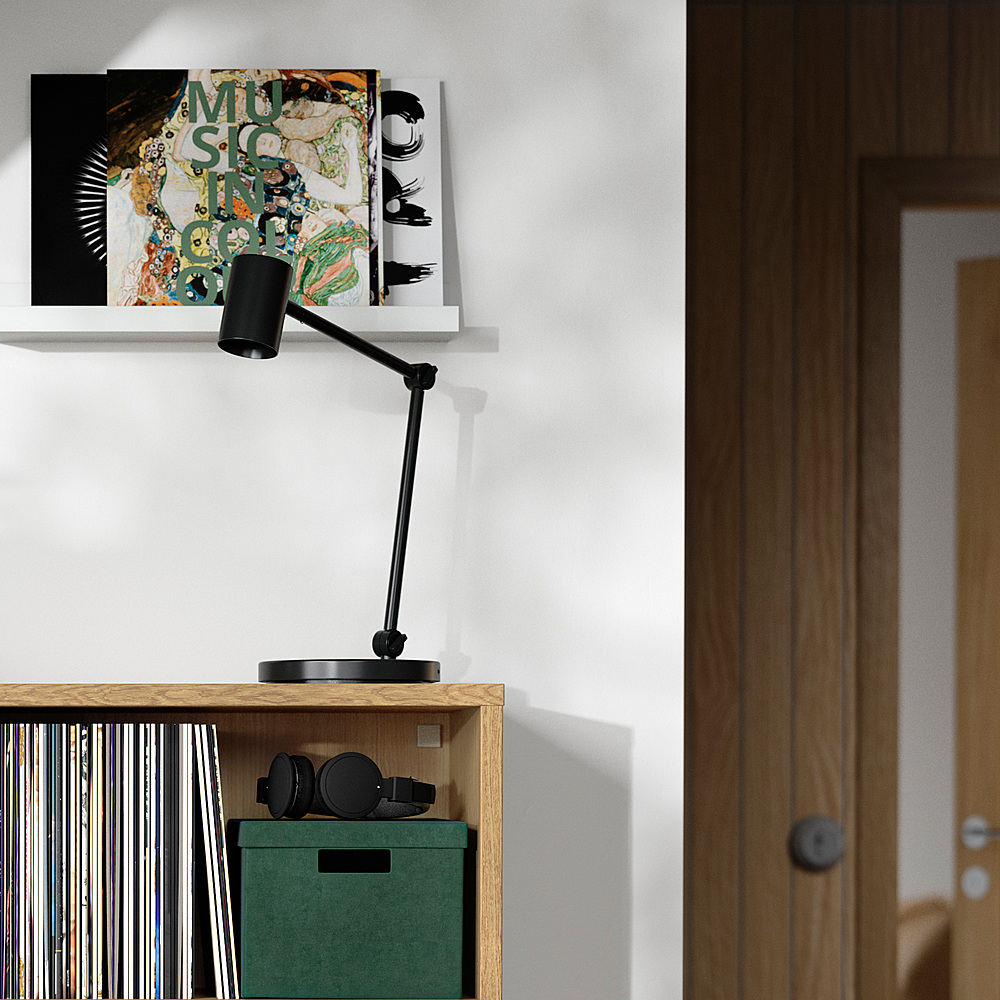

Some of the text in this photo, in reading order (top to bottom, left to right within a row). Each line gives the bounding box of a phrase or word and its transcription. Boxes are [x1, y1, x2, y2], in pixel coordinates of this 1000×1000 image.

[188, 80, 283, 123] MU
[191, 125, 280, 169] SIC
[208, 171, 264, 214] IN
[181, 219, 295, 264] COL
